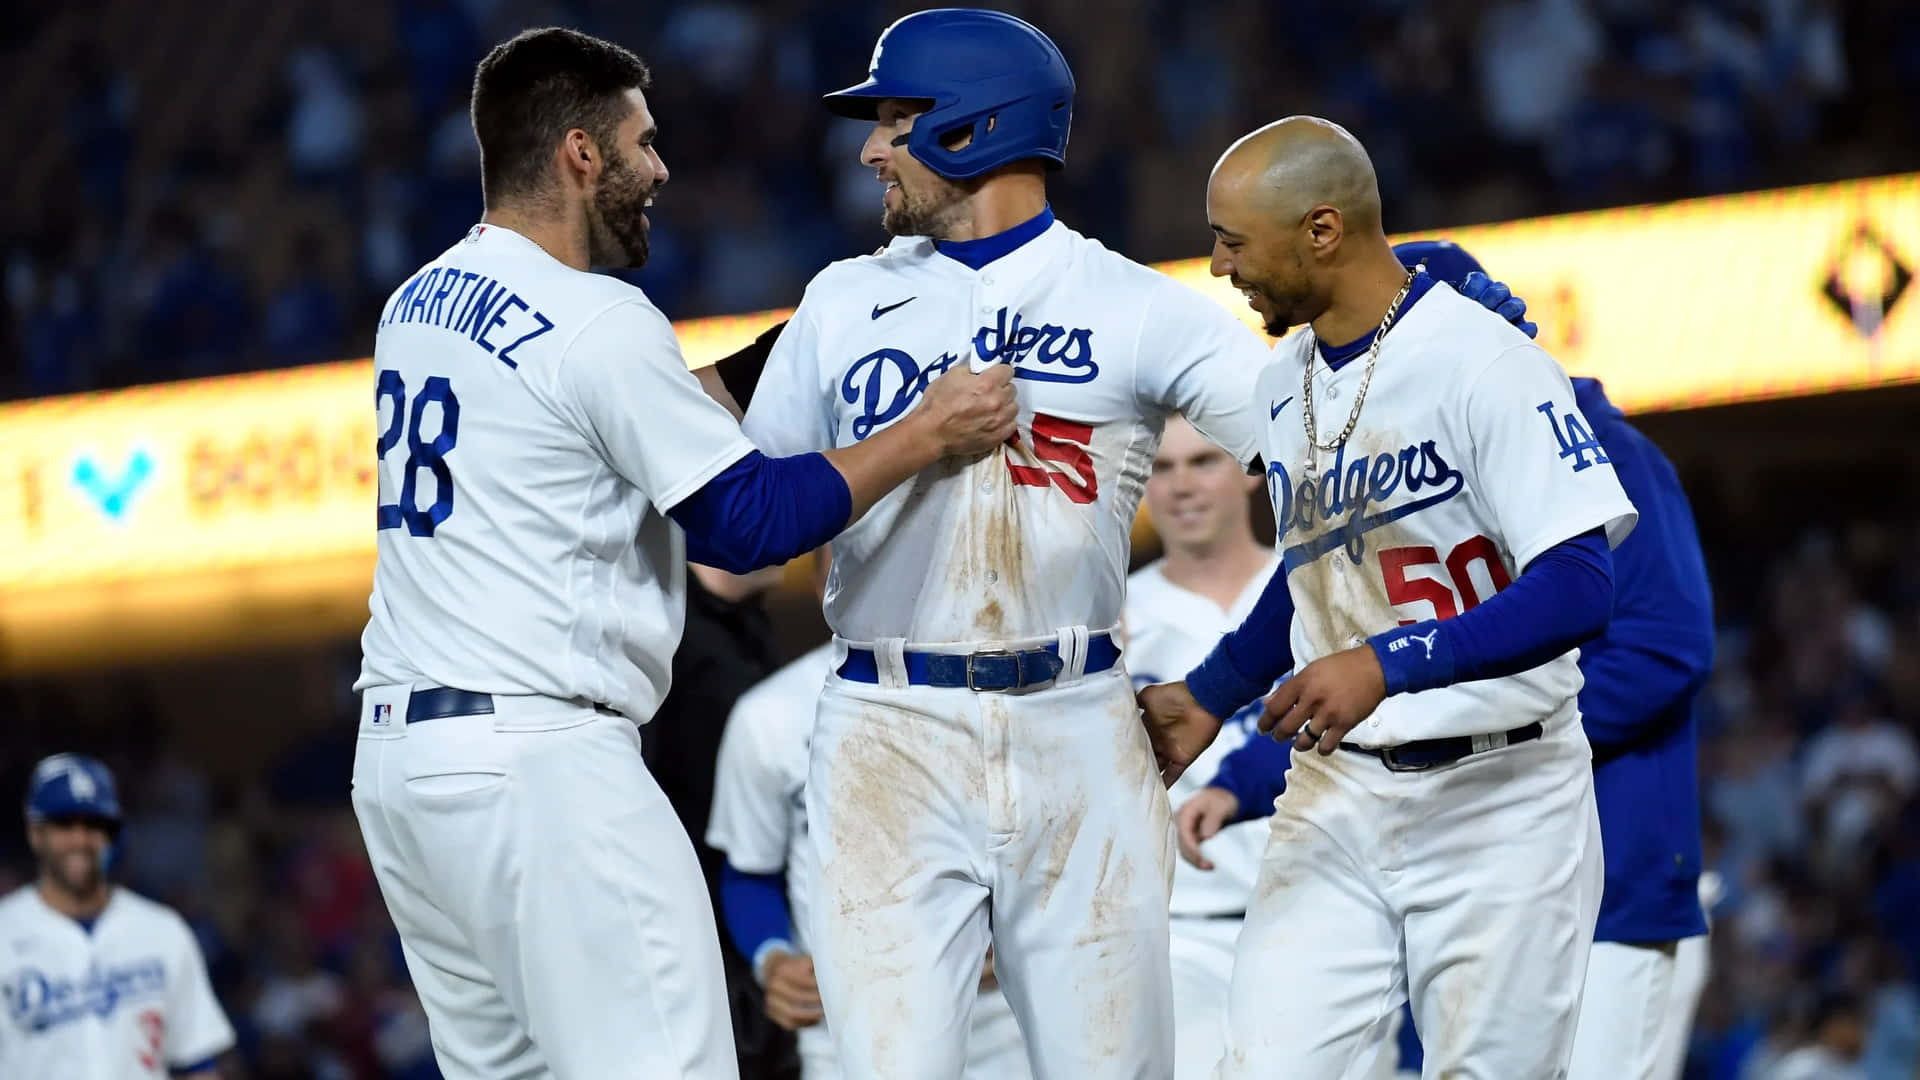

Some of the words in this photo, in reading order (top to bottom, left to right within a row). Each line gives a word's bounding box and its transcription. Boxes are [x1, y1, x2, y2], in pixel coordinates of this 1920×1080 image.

[842, 306, 1098, 440] Doders
[1536, 400, 1610, 472] LA
[376, 369, 460, 538] 28
[1267, 439, 1464, 575] Dodgers
[1377, 534, 1512, 627] 50
